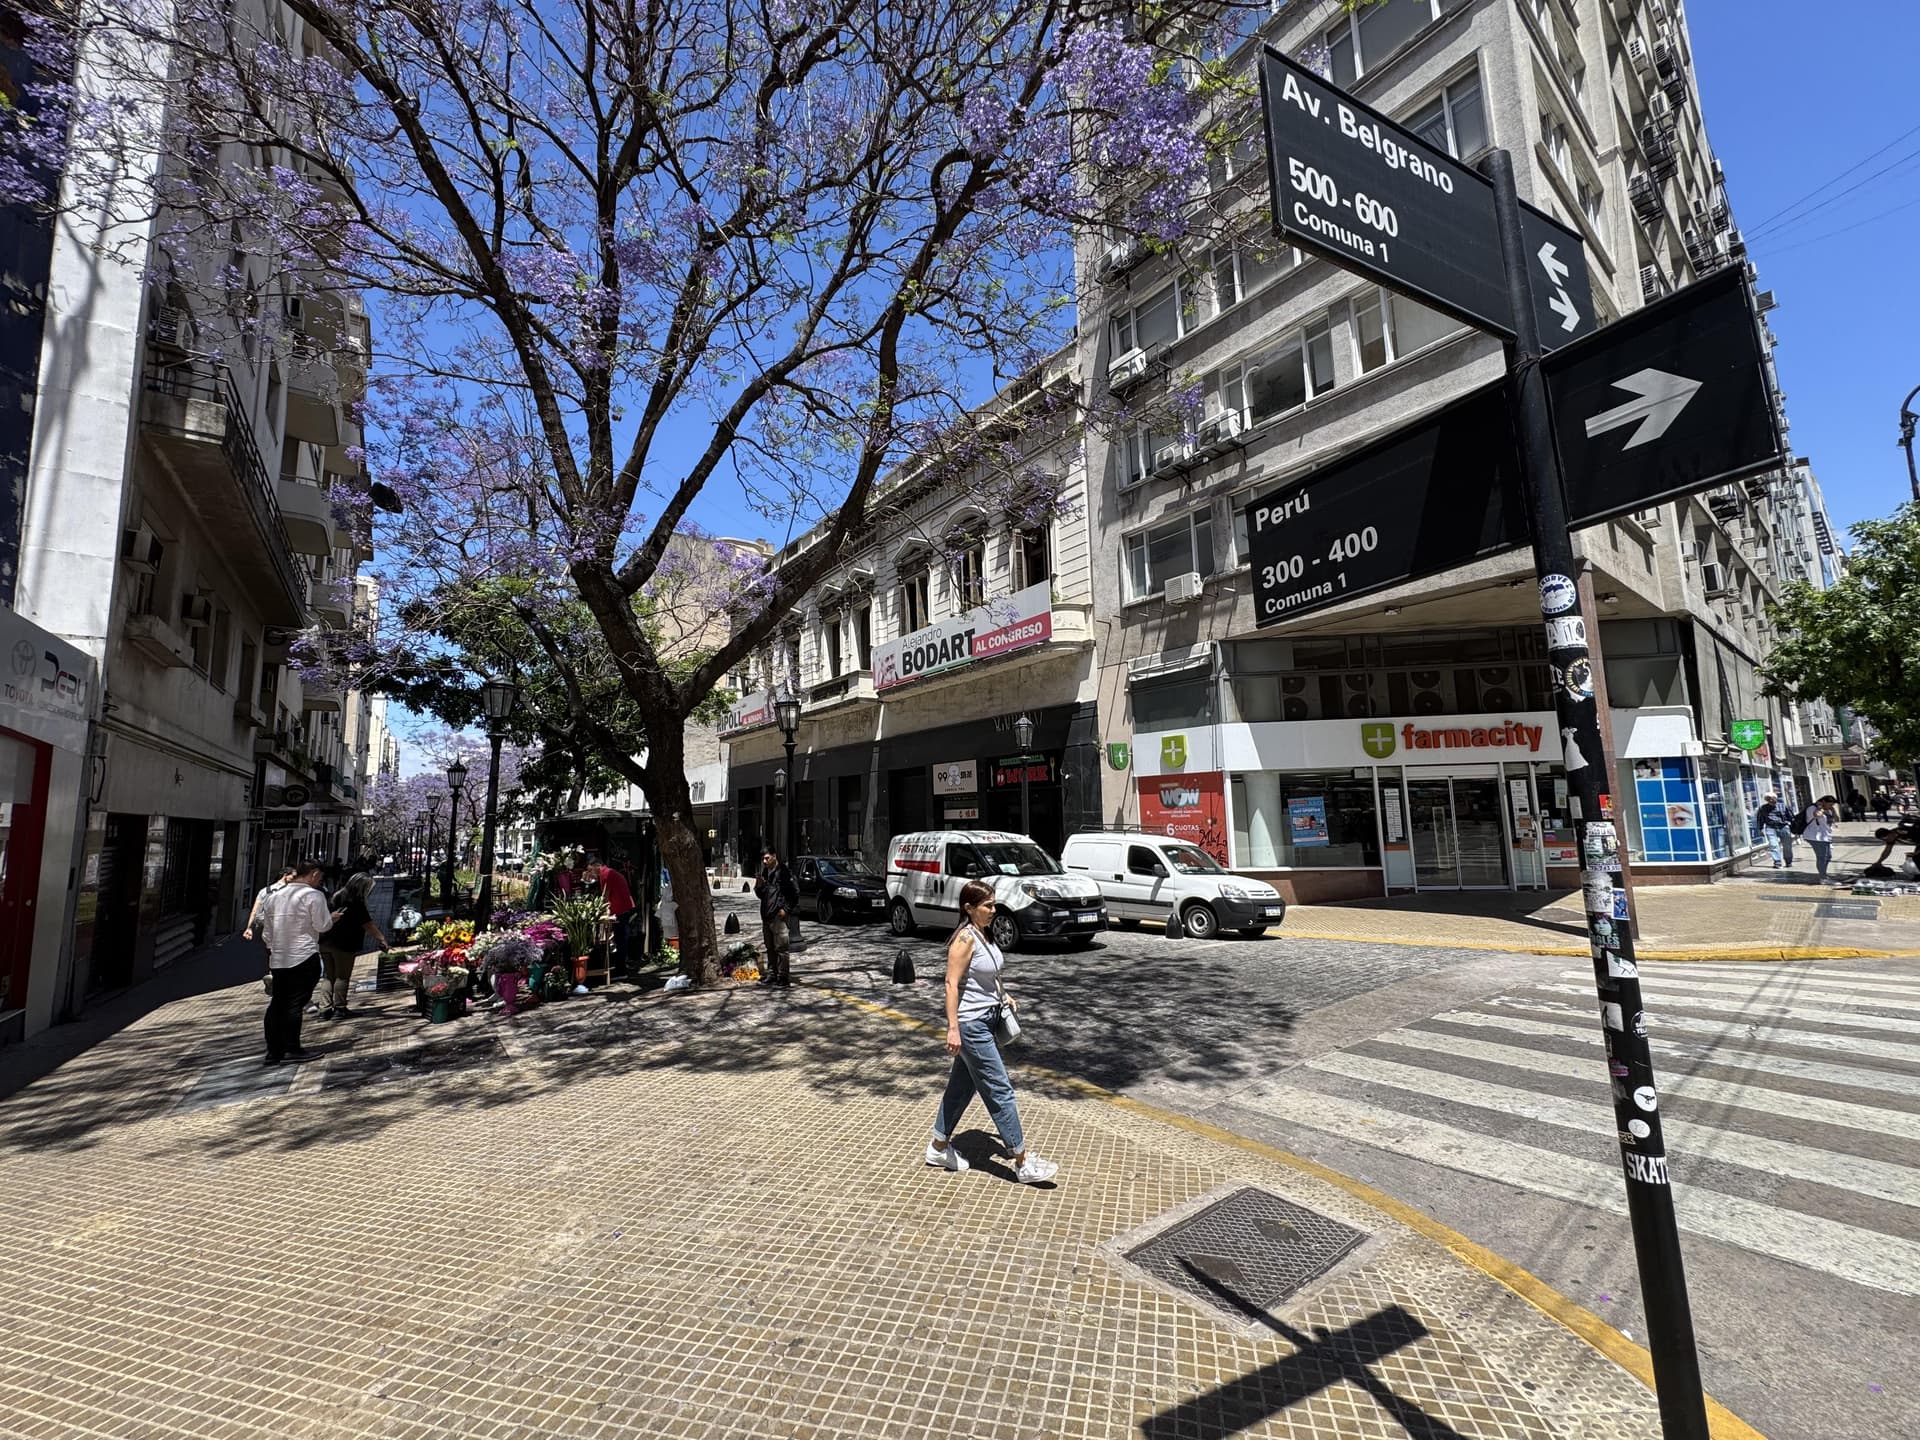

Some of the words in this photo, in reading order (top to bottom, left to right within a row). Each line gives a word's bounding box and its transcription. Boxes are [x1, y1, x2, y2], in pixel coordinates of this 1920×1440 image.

[1281, 72, 1330, 125] Av.
[1338, 104, 1454, 194] Belgrano
[1288, 157, 1337, 208] 500
[1355, 192, 1398, 238] 600
[1294, 202, 1375, 257] Comuna
[1380, 243, 1389, 263] 1
[1255, 489, 1310, 531] Perú
[1262, 556, 1304, 588] 300
[1329, 526, 1378, 562] 400
[1264, 581, 1333, 614] Comuna
[1338, 572, 1347, 588] 1
[902, 626, 943, 650] Alejandro
[902, 627, 975, 676] BODART
[975, 640, 987, 653] AL
[988, 621, 1043, 649] CONGRESO
[4, 683, 34, 705] TOYOTA
[1401, 720, 1543, 752] farmacity
[1160, 787, 1200, 808] WOW
[1166, 823, 1175, 836] 6
